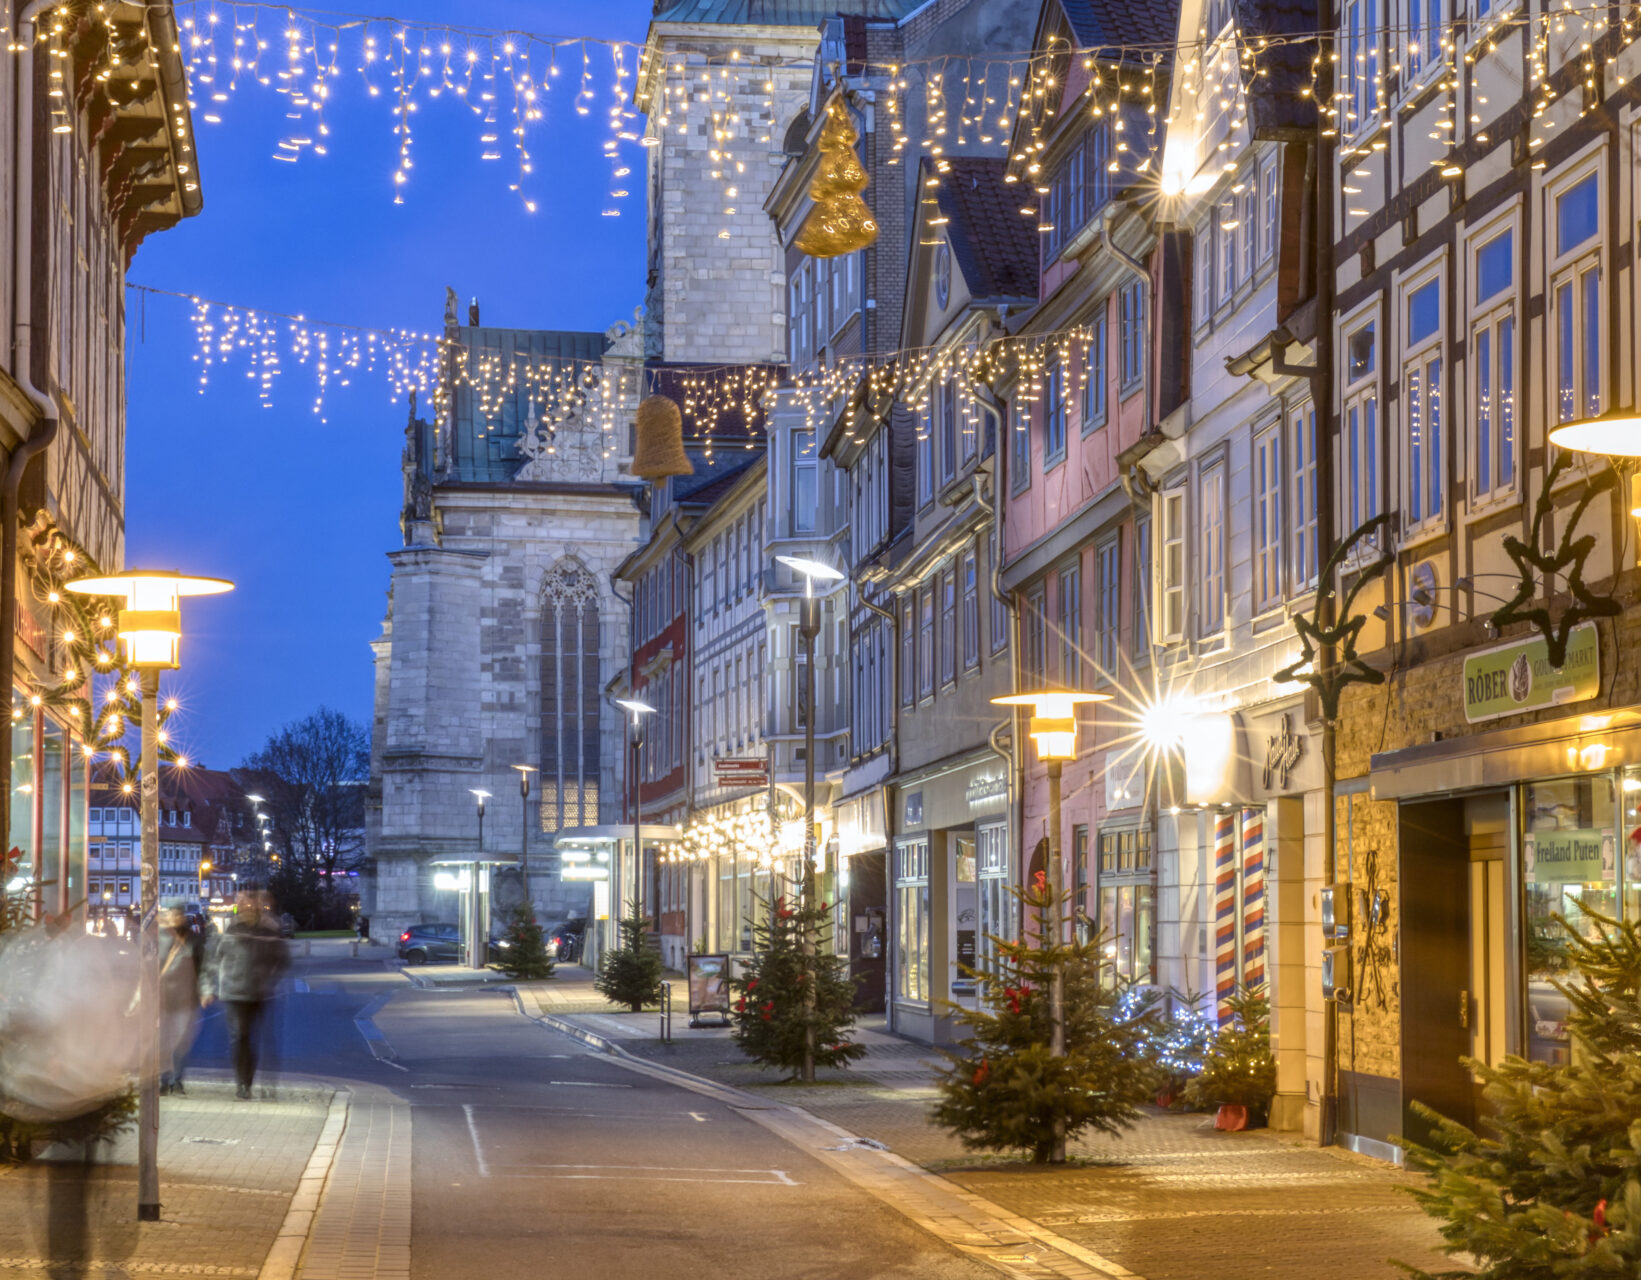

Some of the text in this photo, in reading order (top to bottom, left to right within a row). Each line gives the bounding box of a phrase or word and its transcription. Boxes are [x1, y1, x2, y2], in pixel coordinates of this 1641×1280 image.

[1467, 666, 1508, 705] RÖBER
[1537, 839, 1600, 863] Freiland Puten
